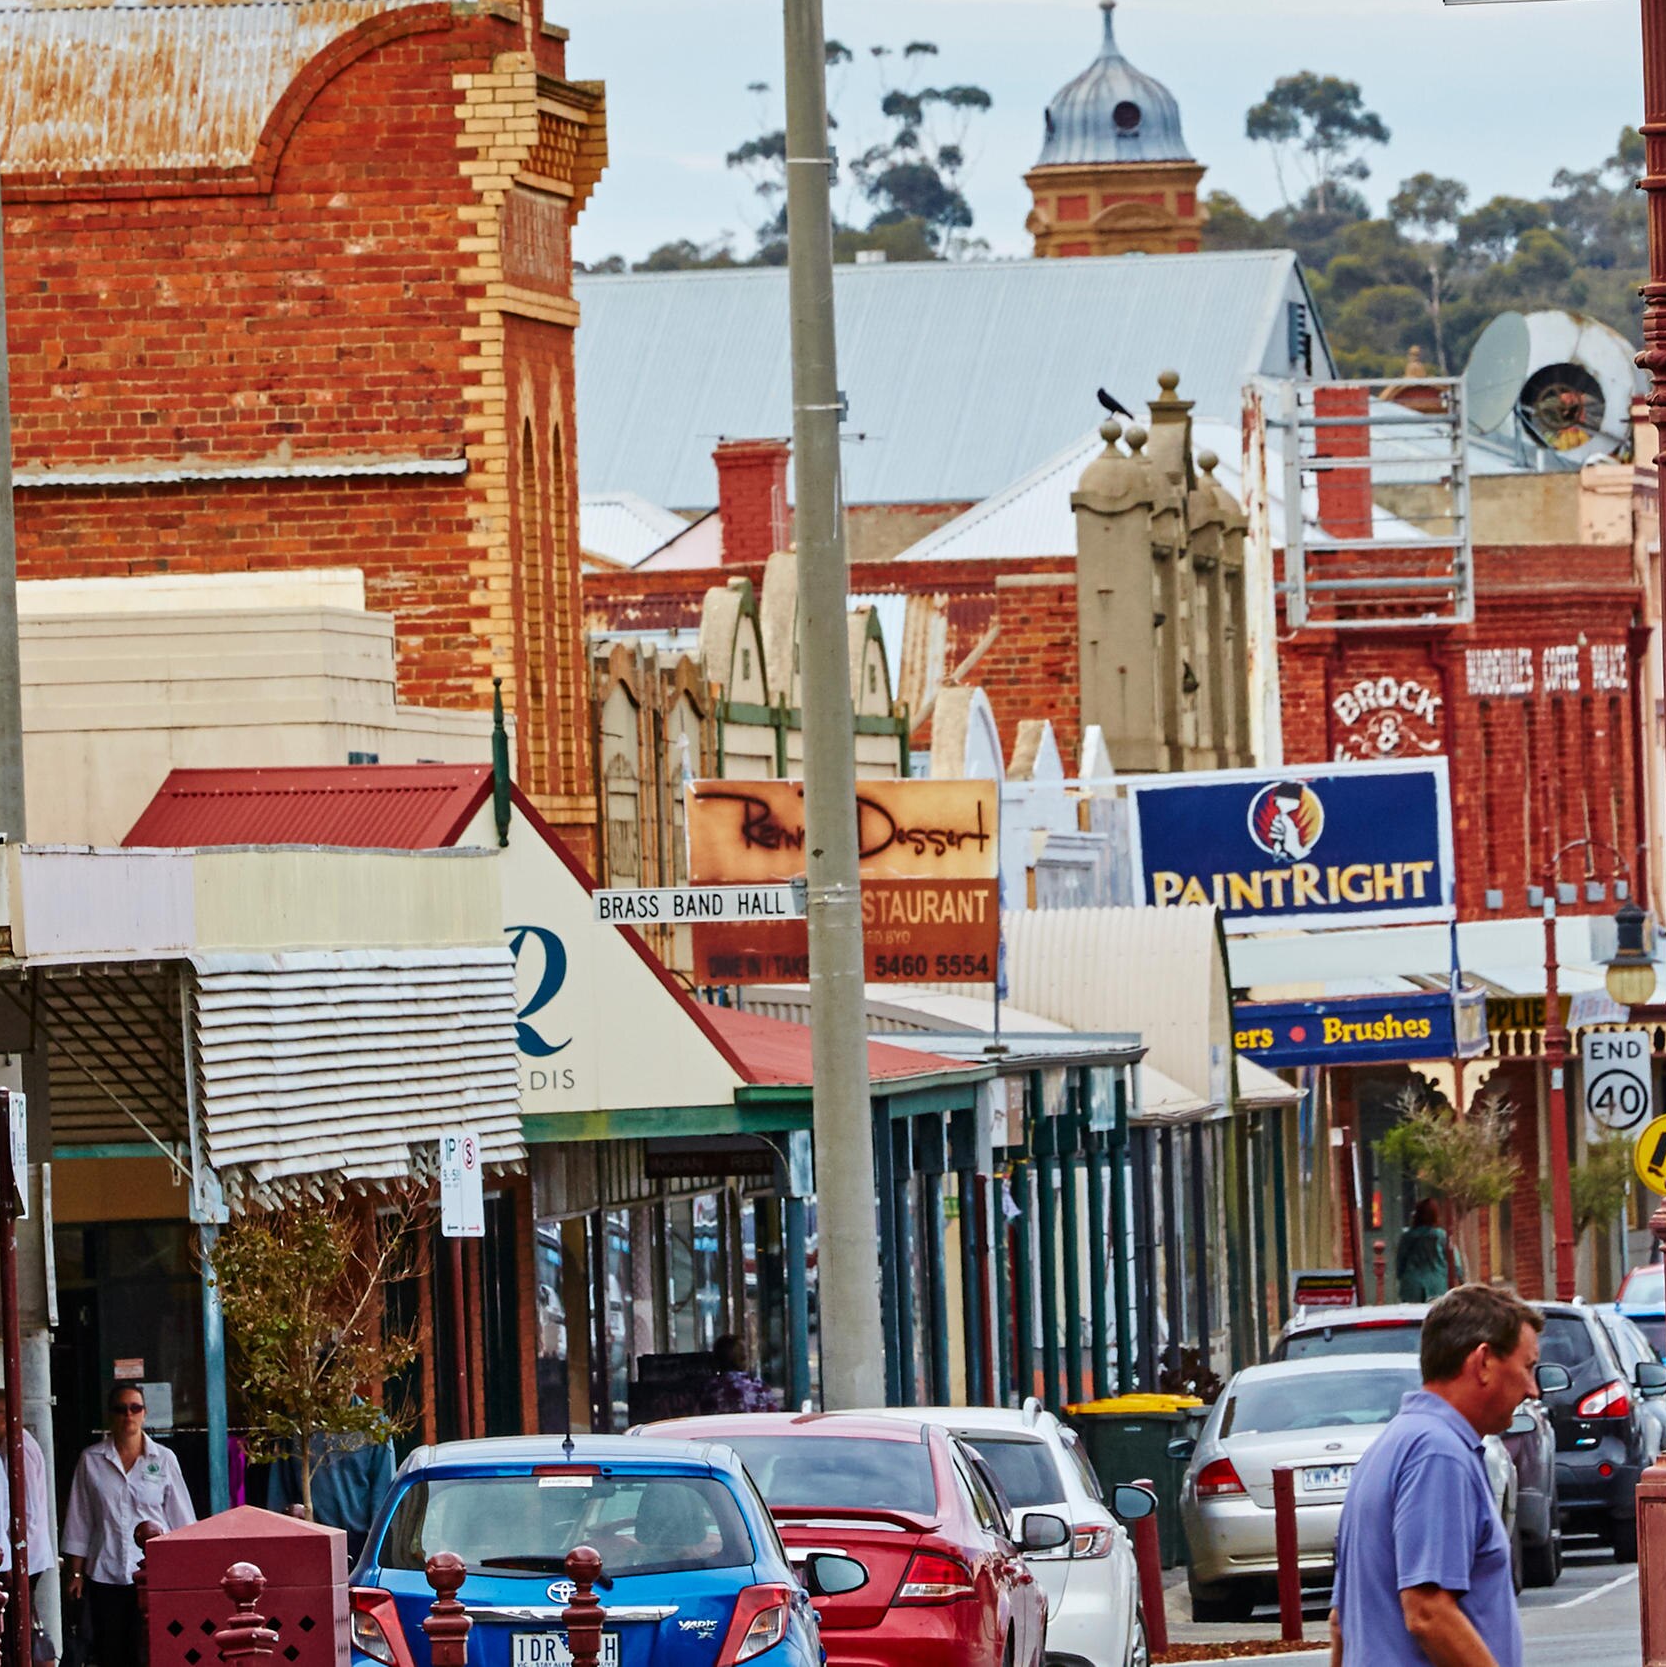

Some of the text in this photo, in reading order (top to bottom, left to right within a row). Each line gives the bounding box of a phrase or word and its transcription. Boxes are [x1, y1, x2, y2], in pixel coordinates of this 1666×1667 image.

[1332, 676, 1443, 726] BROCK
[599, 891, 786, 920] BRASS BAND HALL
[862, 889, 989, 925] STAURANT
[875, 953, 989, 977] 5460 5554
[1235, 1013, 1431, 1049] ers Brushes
[1590, 1040, 1641, 1061] END
[1595, 1085, 1640, 1115] 40
